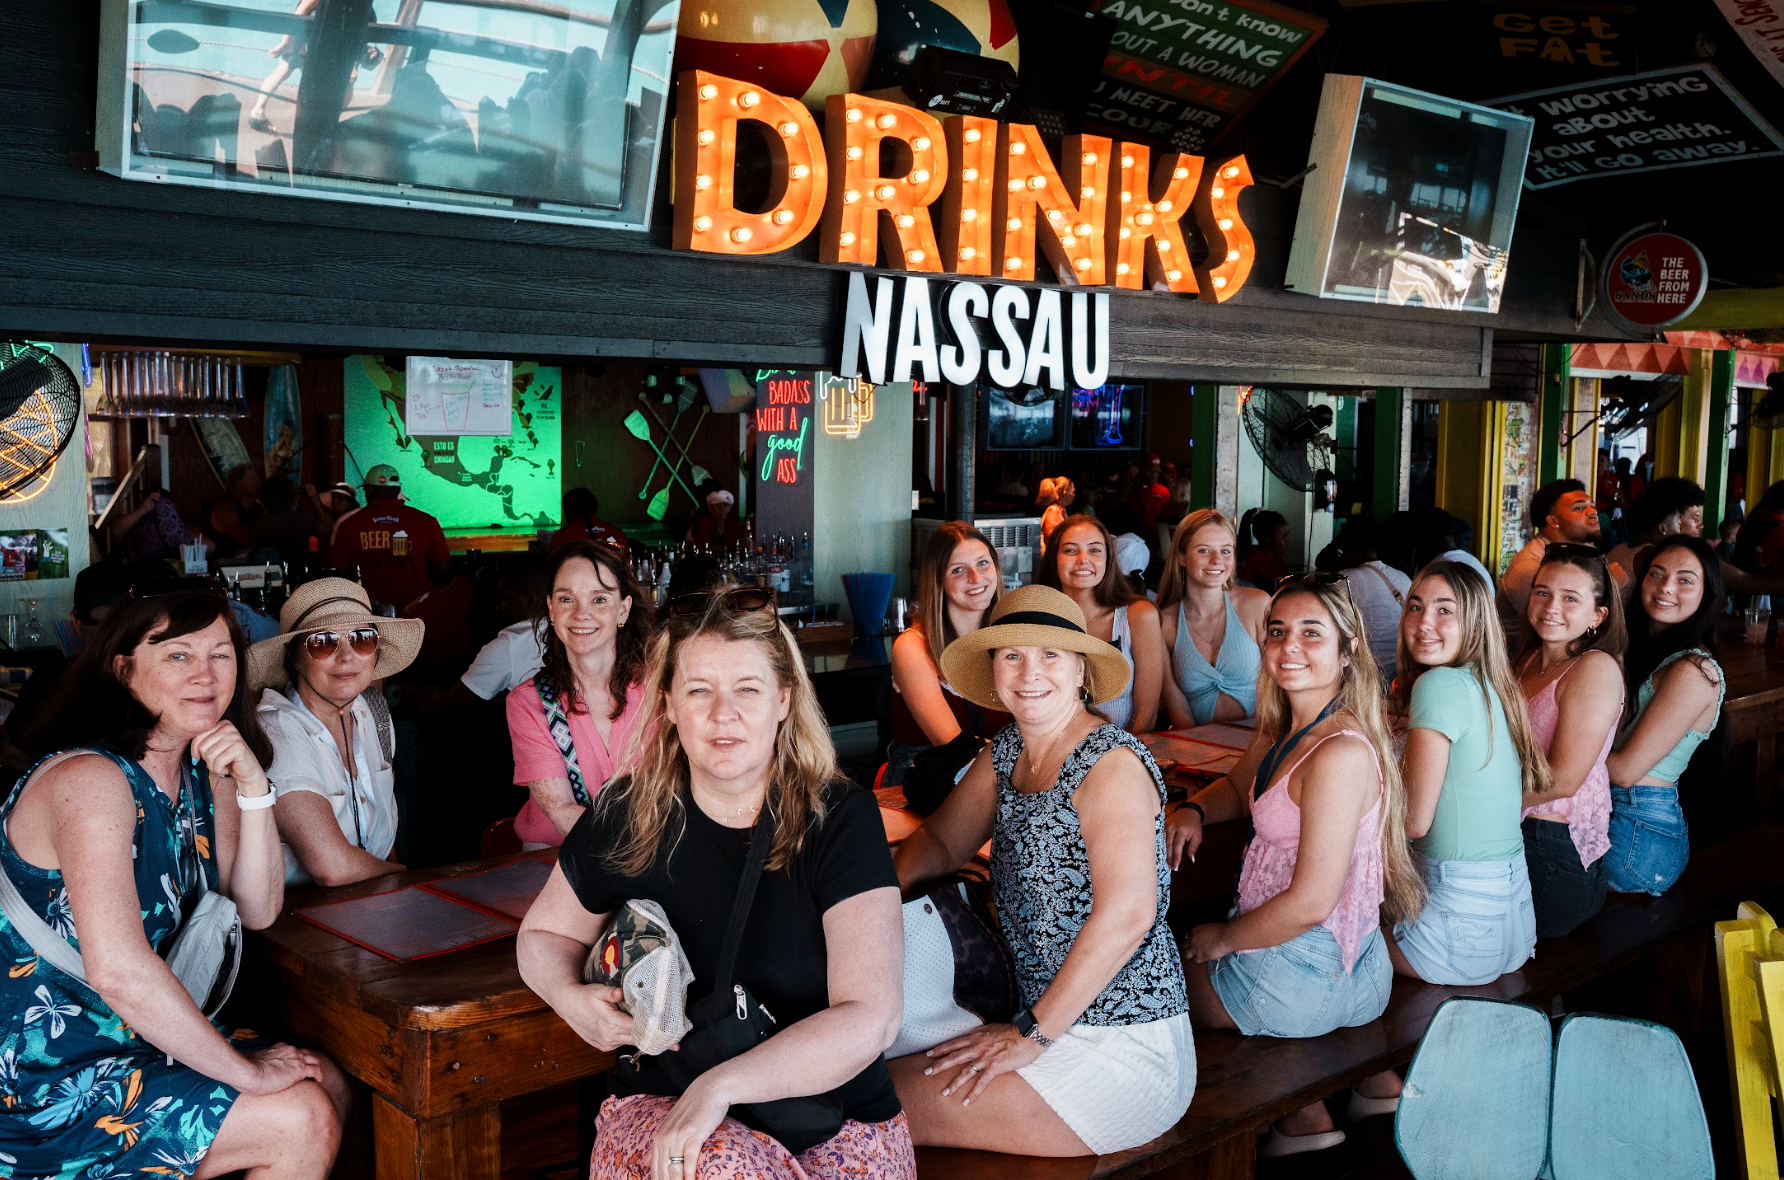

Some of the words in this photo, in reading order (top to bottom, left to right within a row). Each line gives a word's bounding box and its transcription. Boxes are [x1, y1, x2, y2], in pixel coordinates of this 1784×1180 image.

[1102, 0, 1283, 67] ANYTHING
[1235, 13, 1303, 43] know
[1492, 13, 1620, 39] Get
[1110, 31, 1158, 54] OUT
[1157, 46, 1174, 61] A
[1178, 51, 1267, 88] WOMAN
[1104, 55, 1234, 107] NTIL
[1085, 102, 1175, 135] COUR
[1108, 86, 1177, 113] MEET
[1177, 106, 1222, 128] HER
[1528, 138, 1596, 163] your
[1606, 121, 1732, 149] health.
[1651, 139, 1761, 162] away.
[674, 69, 1255, 304] DRINKS
[1660, 268, 1690, 280] BEER
[1662, 257, 1685, 268] THE
[1615, 291, 1656, 300] SANDS
[1657, 292, 1687, 304] HERE
[1658, 281, 1690, 292] FROM
[840, 271, 1110, 390] NASSAU
[769, 379, 811, 405] BADASS
[756, 407, 784, 432] WITH
[789, 407, 798, 430] A
[761, 417, 808, 481] good
[777, 458, 796, 483] ASS
[360, 531, 390, 550] BEER
